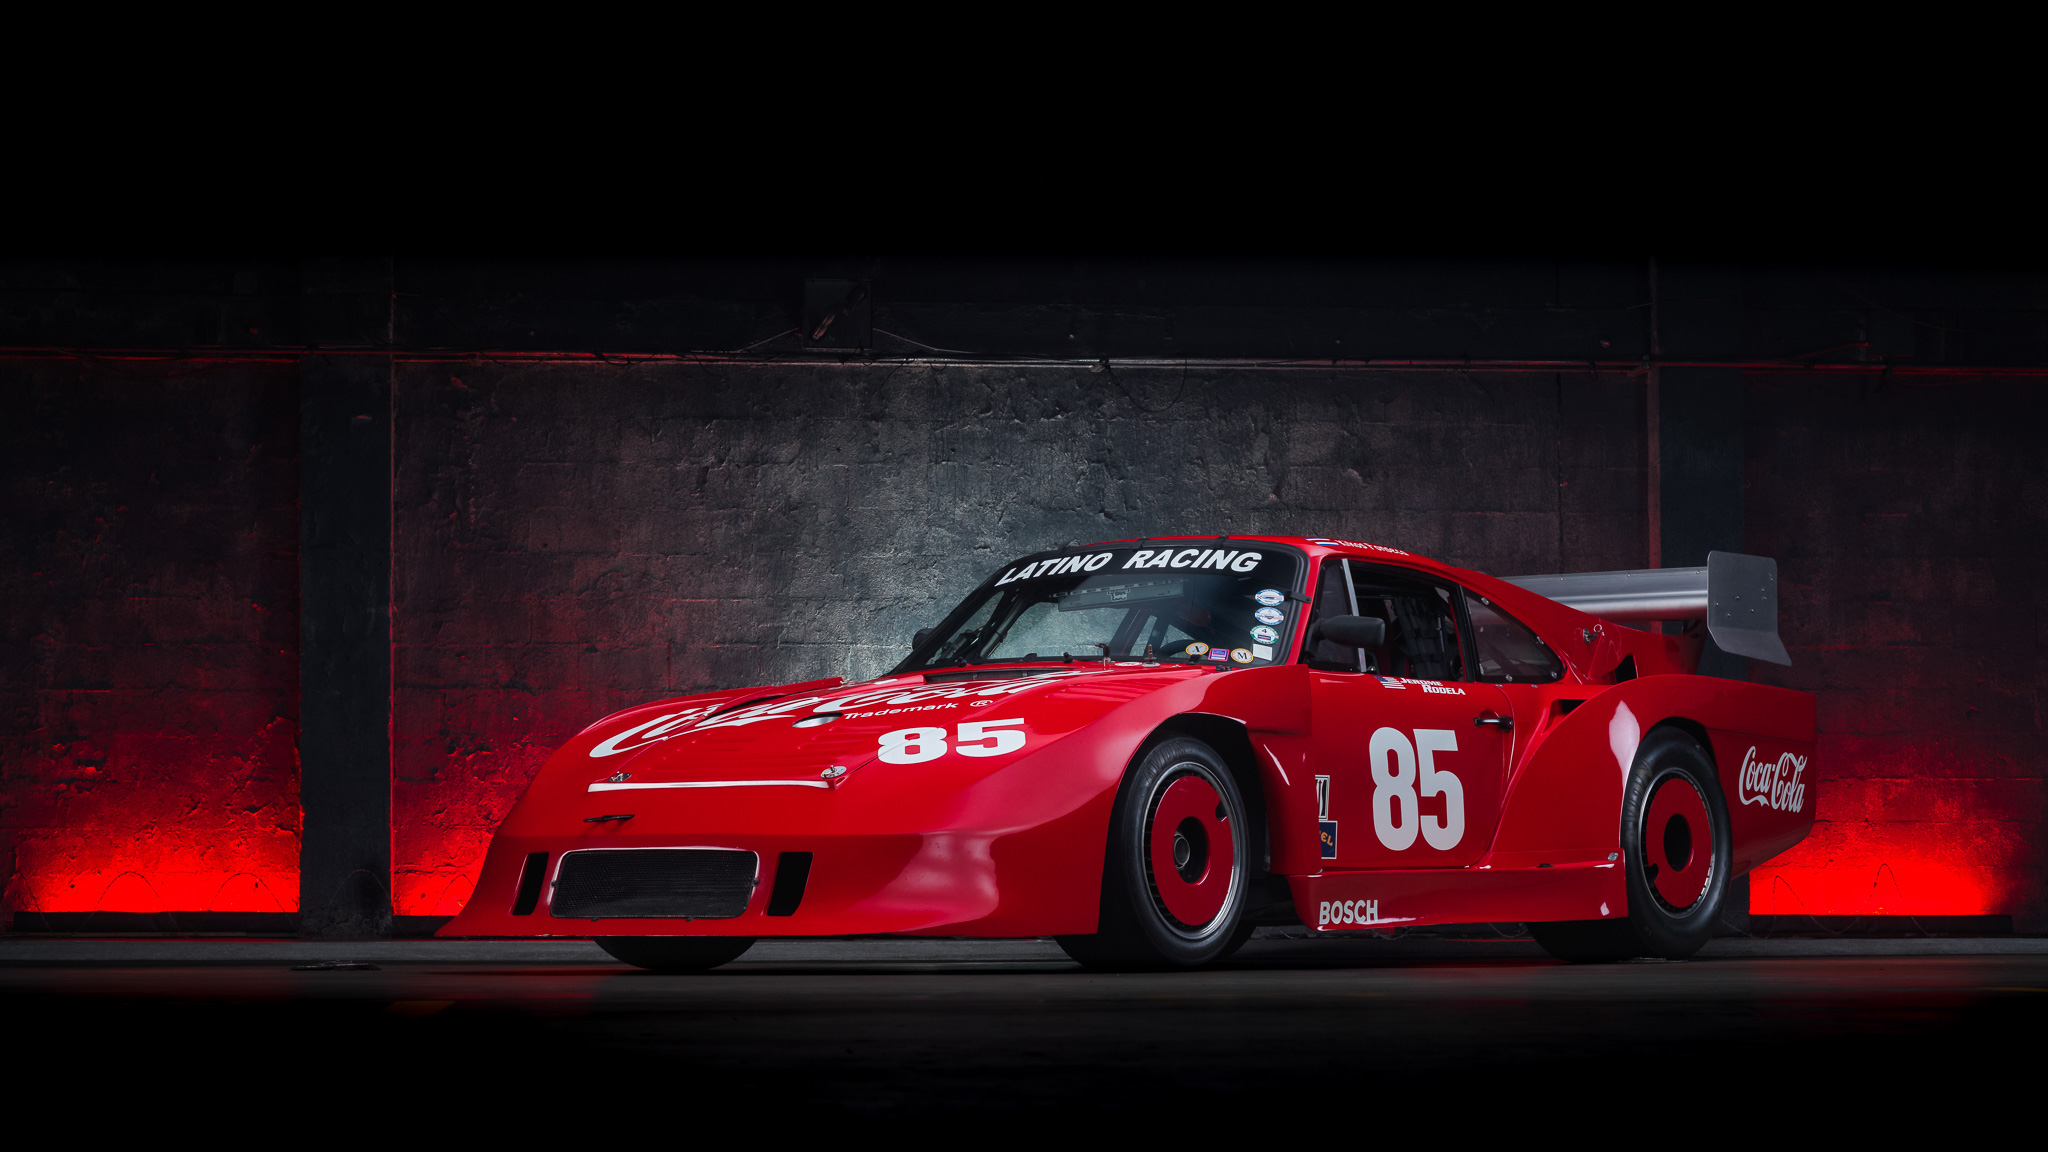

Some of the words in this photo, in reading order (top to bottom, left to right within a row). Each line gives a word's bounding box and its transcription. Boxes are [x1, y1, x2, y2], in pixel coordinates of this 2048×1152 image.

[995, 552, 1113, 587] LATINO
[1122, 549, 1262, 573] RACING
[1237, 652, 1248, 660] M
[1421, 684, 1466, 696] RODELA
[844, 702, 959, 720] Trademark
[878, 718, 1026, 764] 85
[1369, 727, 1465, 851] 85
[1739, 746, 1807, 813] Coca-Cola
[1320, 831, 1333, 847] EL
[1319, 900, 1378, 925] BOSCH
